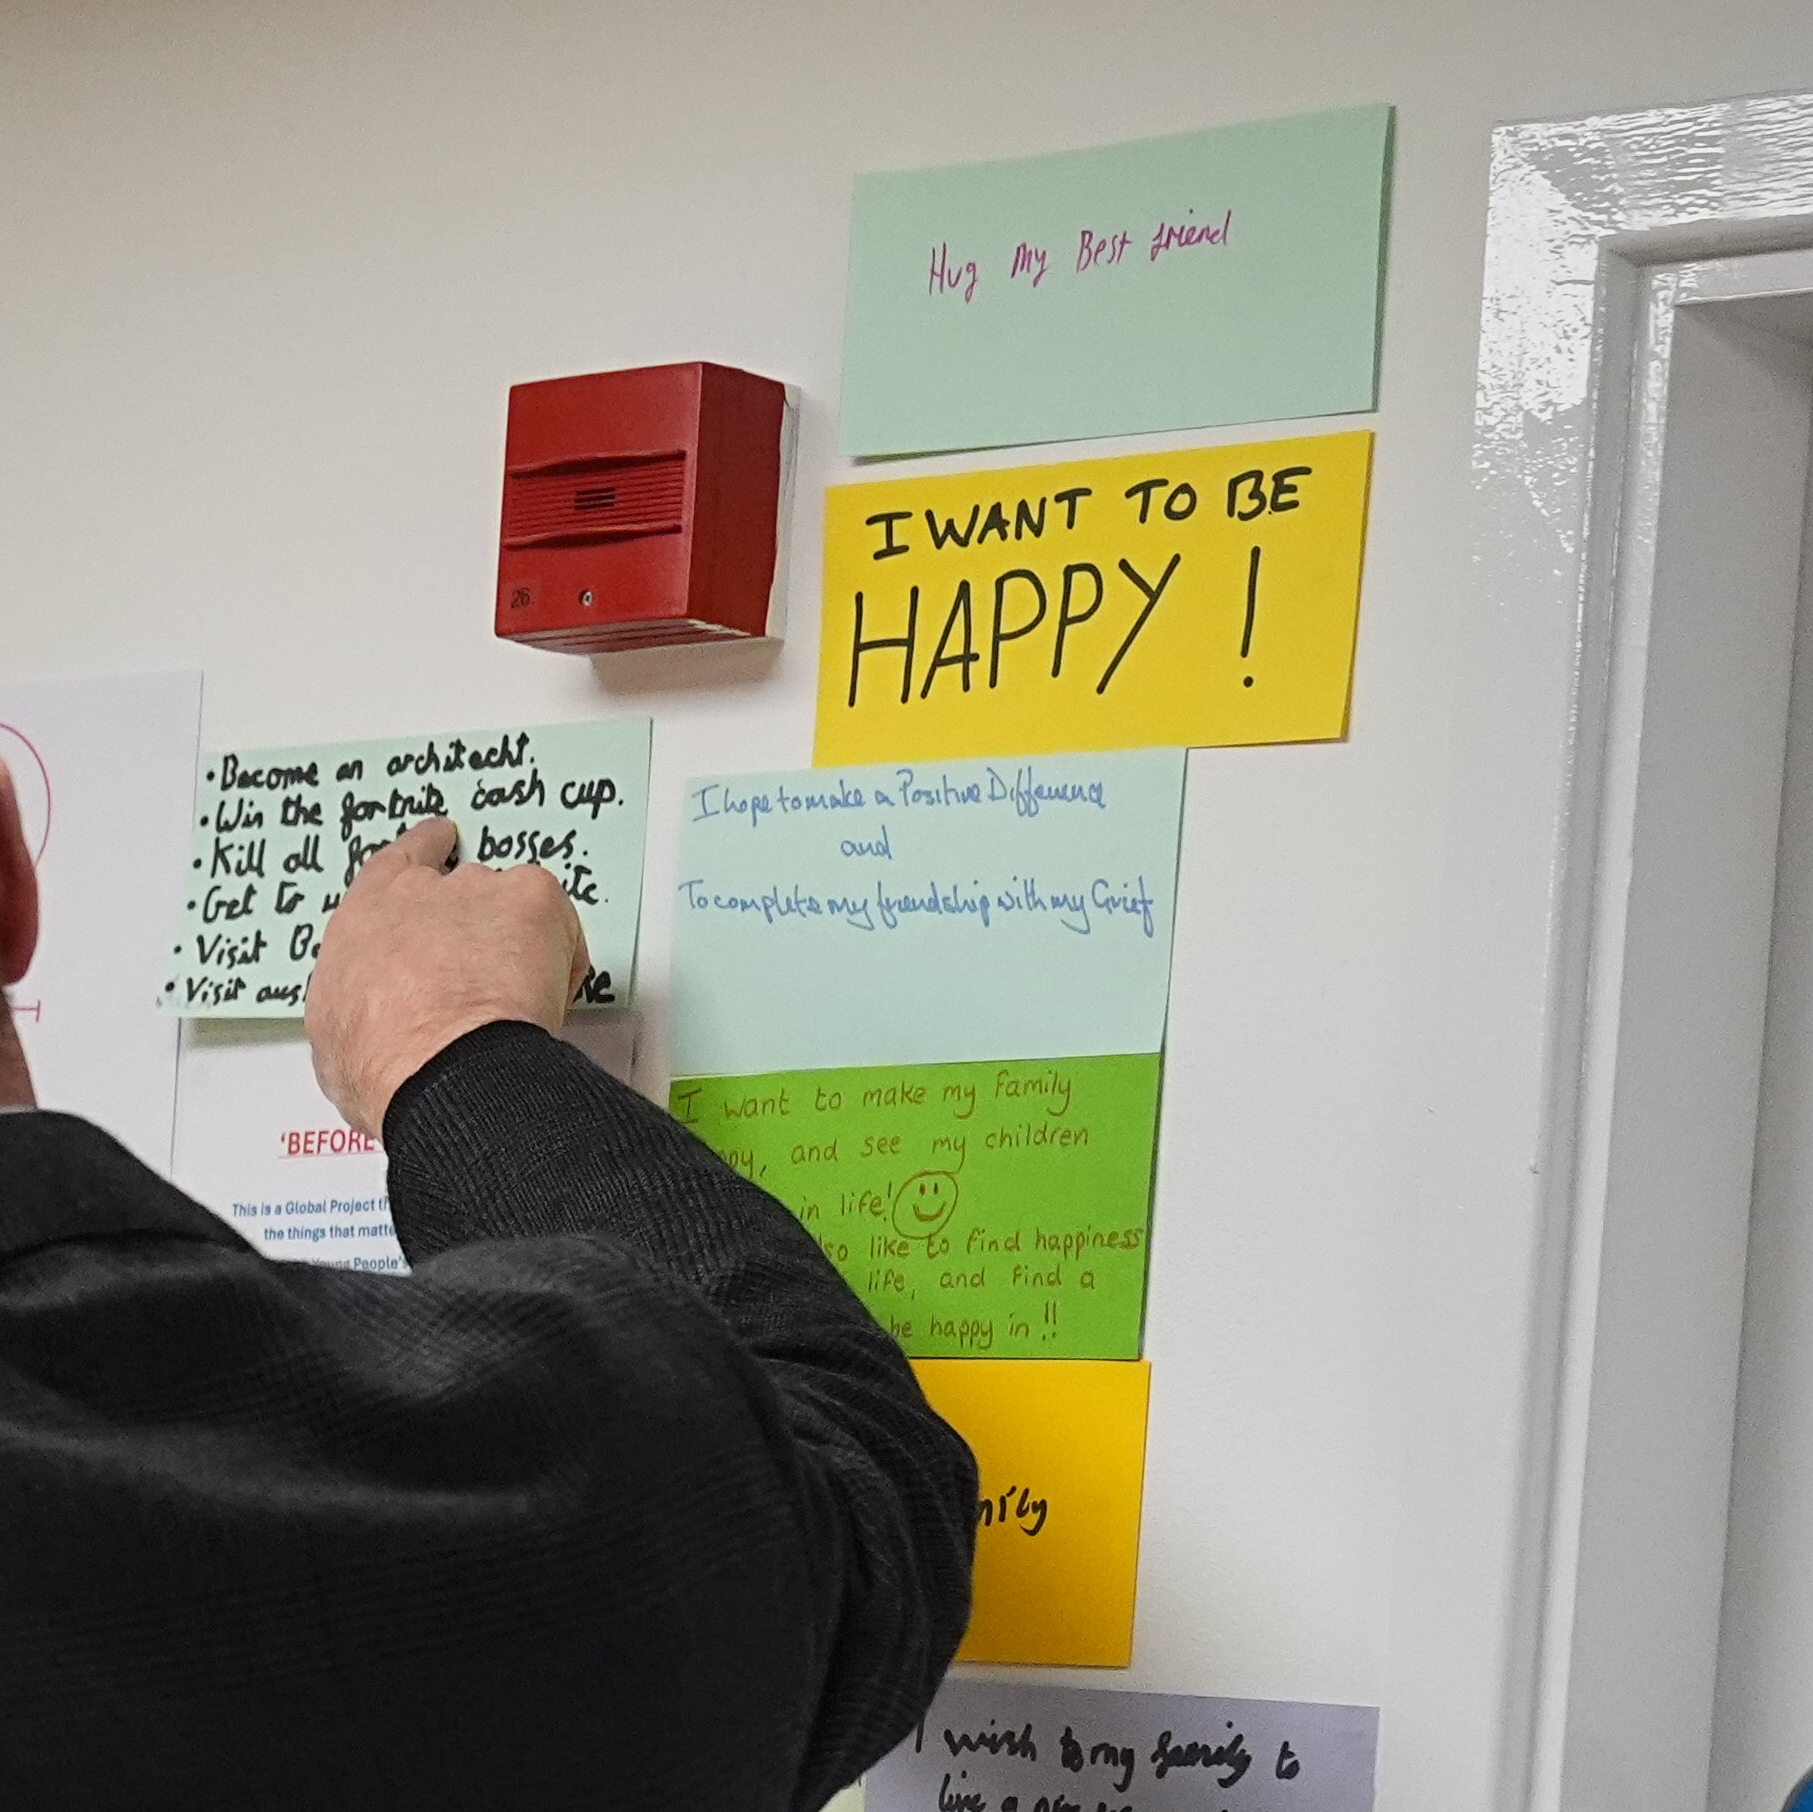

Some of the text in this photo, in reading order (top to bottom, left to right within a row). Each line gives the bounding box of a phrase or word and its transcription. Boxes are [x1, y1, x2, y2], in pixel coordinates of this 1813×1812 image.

[929, 208, 1232, 303] Hug Best friend
[866, 466, 1313, 560] I WANT TO BE
[848, 553, 1181, 708] HAPPY
[221, 753, 363, 791] Become an
[215, 768, 624, 833] Win the cash cup.
[211, 836, 266, 879] Kill
[283, 835, 324, 873] all
[840, 825, 892, 861] and
[201, 884, 258, 923] Get
[276, 883, 304, 914] to
[829, 891, 875, 931] my
[197, 933, 268, 970] Visit
[186, 977, 247, 1004] Visit
[678, 1081, 976, 1125] I want to make my
[791, 1138, 838, 1165] and
[861, 1135, 902, 1157] see
[932, 1135, 966, 1173] my
[985, 1122, 1090, 1149] children
[231, 1203, 257, 1218] This
[261, 1202, 271, 1216] is
[274, 1204, 282, 1216] a
[285, 1199, 326, 1216] Global
[329, 1197, 375, 1216] Project
[799, 1196, 820, 1221] in
[264, 1224, 354, 1243] the things that
[870, 1234, 910, 1259] like
[927, 1233, 950, 1260] to
[966, 1226, 1021, 1255] find
[1034, 1224, 1145, 1261] happiness
[940, 1266, 985, 1289] and
[1080, 1270, 1095, 1290] a
[930, 1312, 994, 1350] happy
[1009, 1312, 1030, 1338] in
[944, 1719, 1037, 1761] wish
[1090, 1742, 1135, 1792] my
[1275, 1740, 1300, 1780] to
